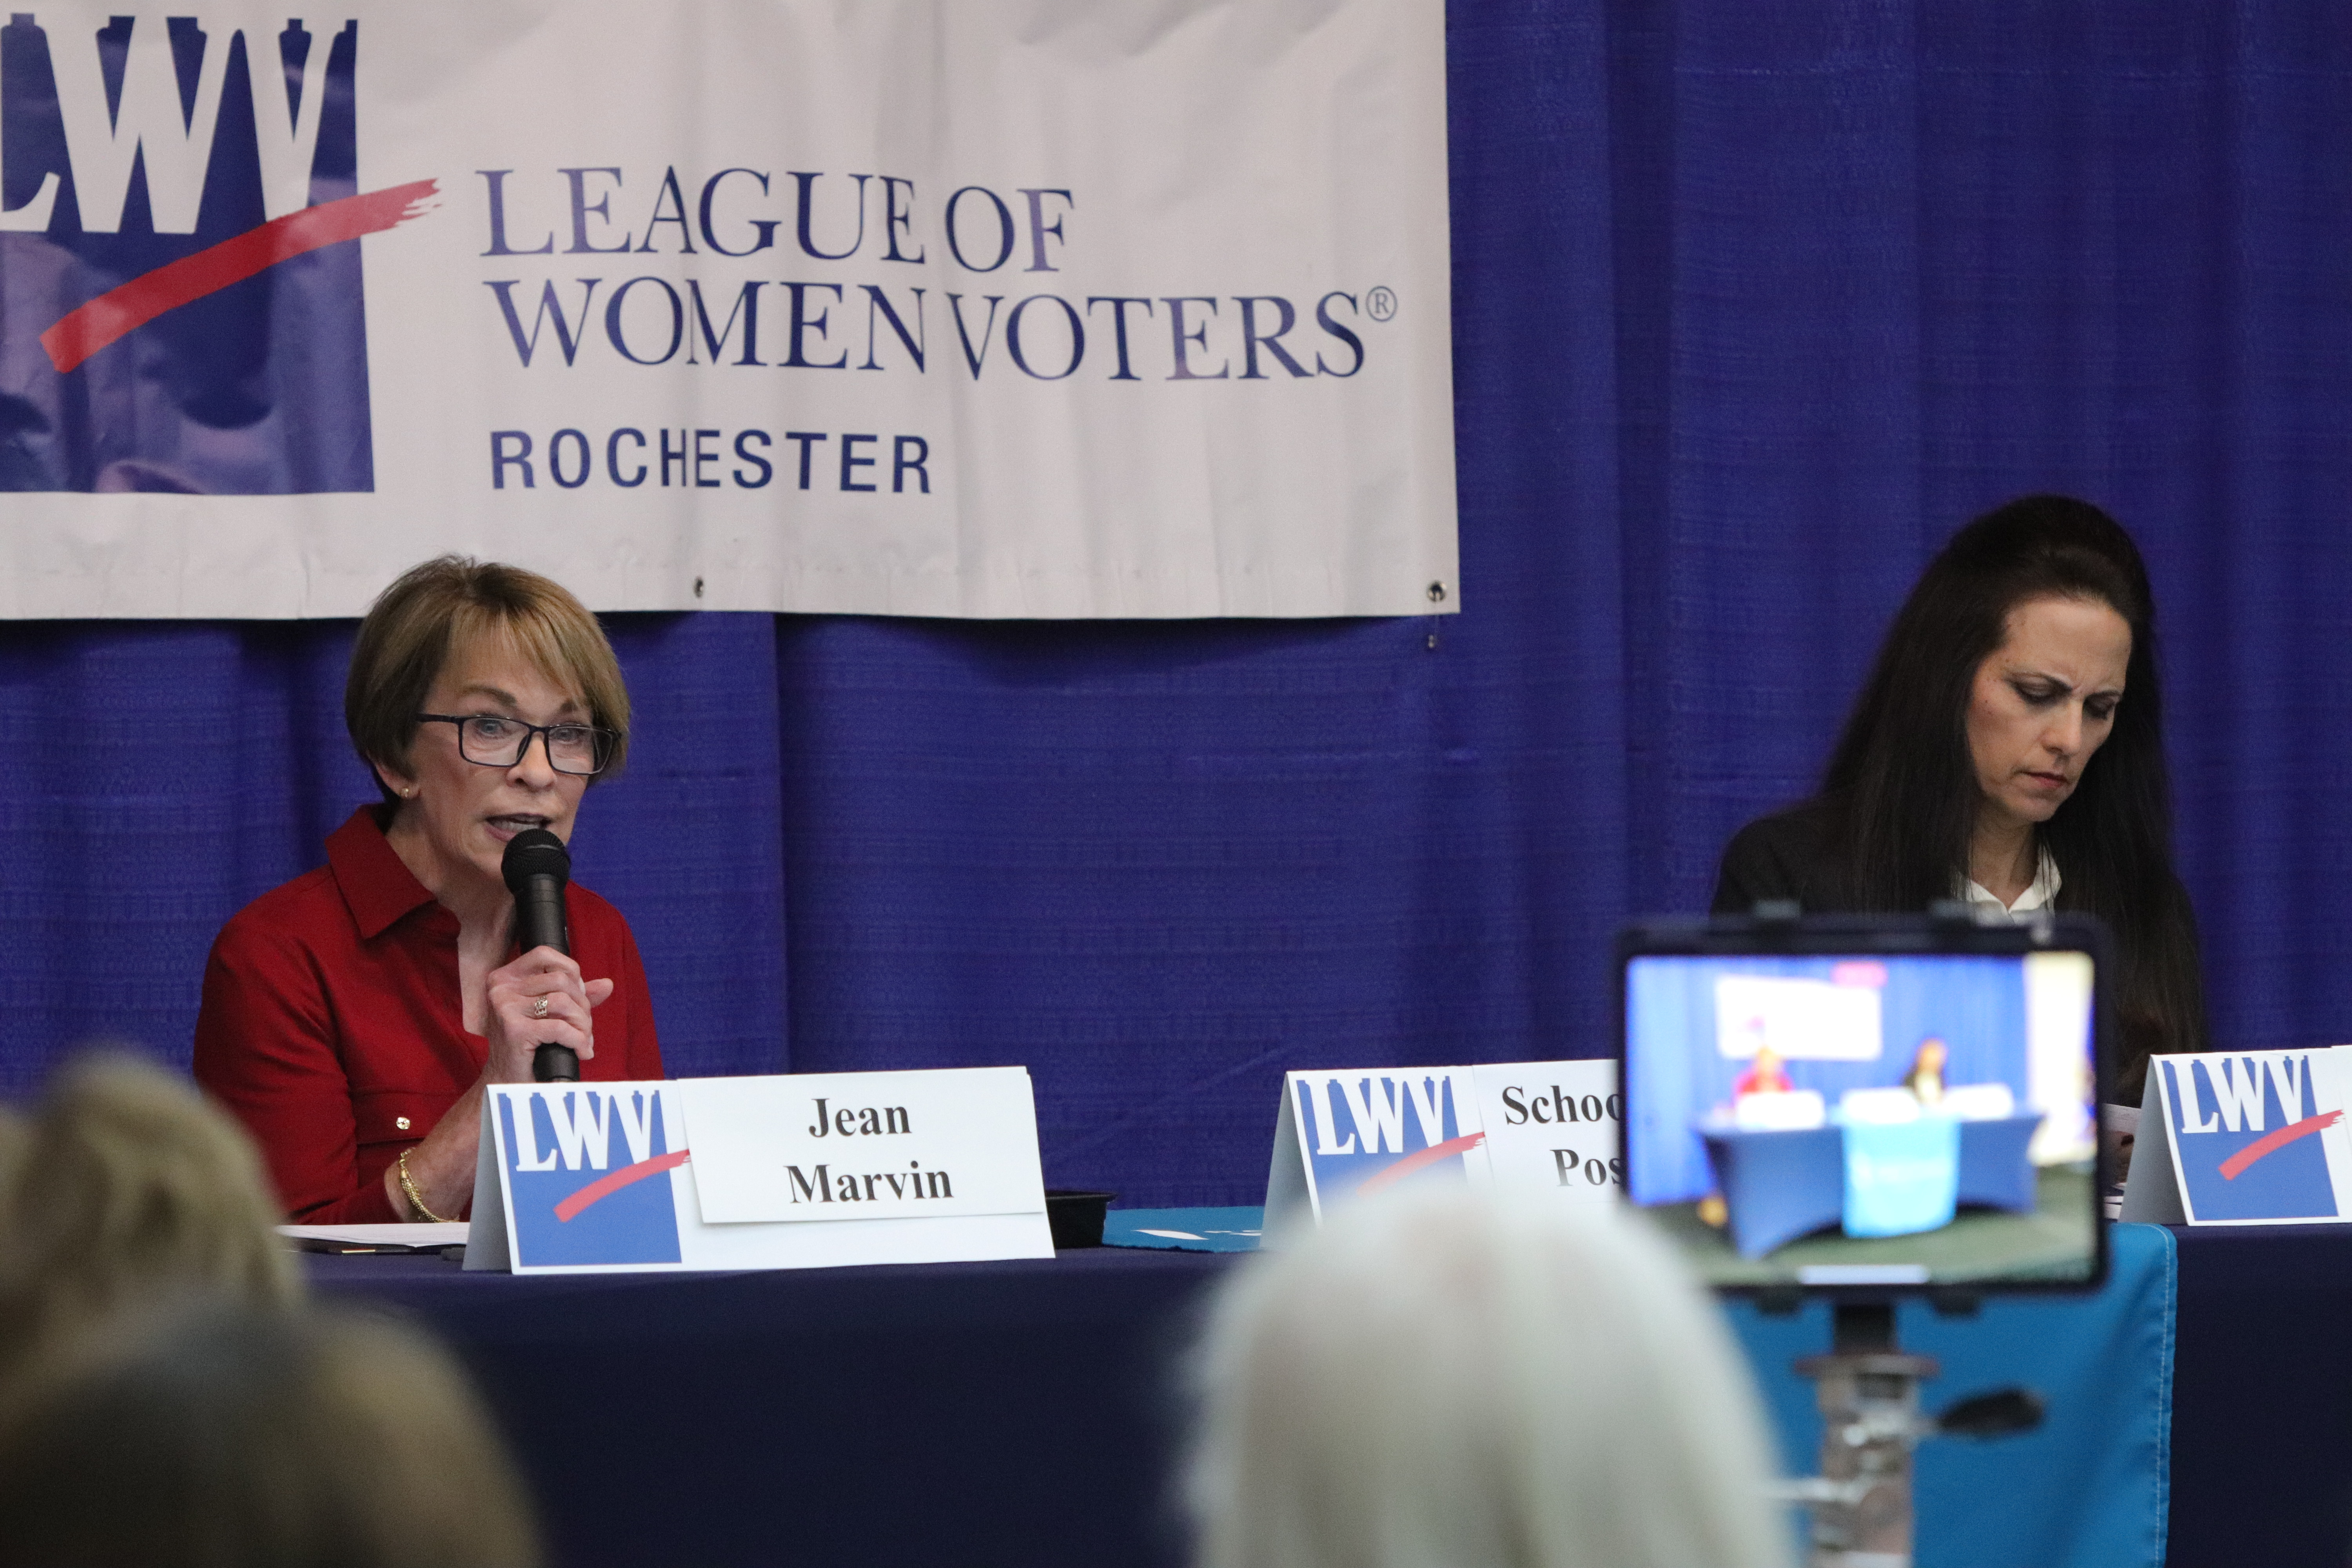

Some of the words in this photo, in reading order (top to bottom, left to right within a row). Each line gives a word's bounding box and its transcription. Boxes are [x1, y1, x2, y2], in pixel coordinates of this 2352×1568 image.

[475, 165, 926, 265] LEAGUE
[945, 186, 1074, 272] OF
[482, 276, 927, 374] WOMEN
[490, 427, 931, 494] ROCHESTER
[506, 1090, 655, 1171] LWV
[808, 1098, 912, 1138] Jean
[1305, 1076, 1447, 1155] LWV
[1502, 1085, 1621, 1125] Schoo
[2170, 1055, 2305, 1134] LWV
[784, 1160, 954, 1203] Marvin
[1550, 1149, 1621, 1187] Pos
